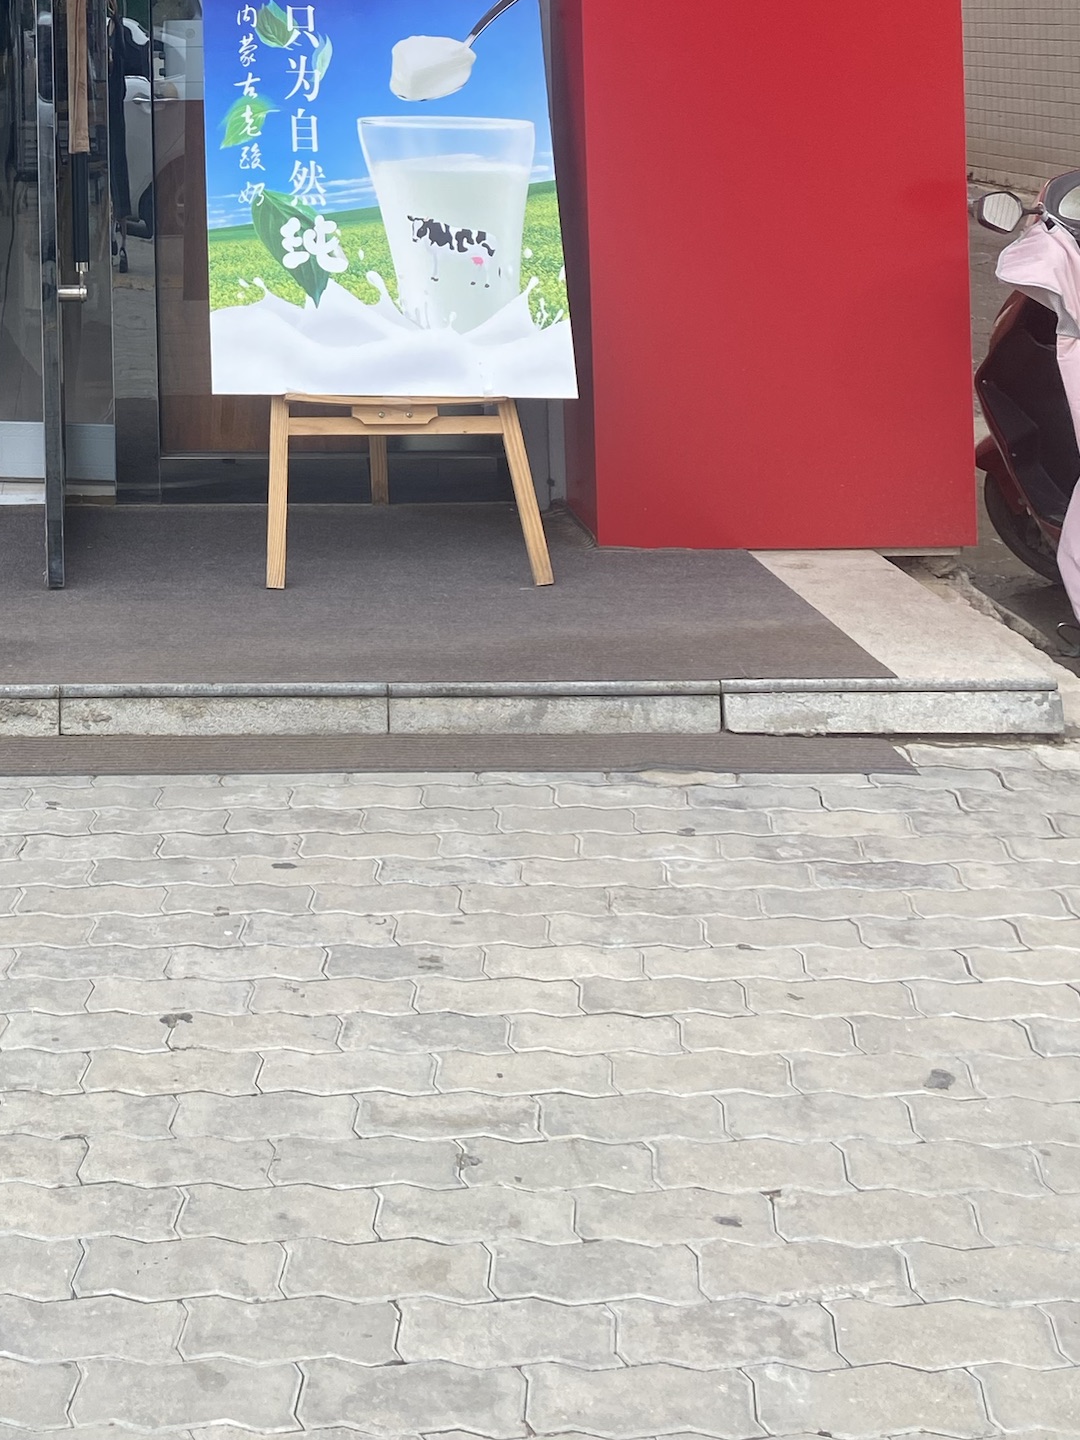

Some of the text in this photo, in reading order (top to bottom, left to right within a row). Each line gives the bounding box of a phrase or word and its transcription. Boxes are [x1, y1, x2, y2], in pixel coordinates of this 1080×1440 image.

[234, 3, 267, 208] 内蒙古老酸奶
[284, 4, 328, 207] 只为自然
[280, 214, 349, 274] 纯
